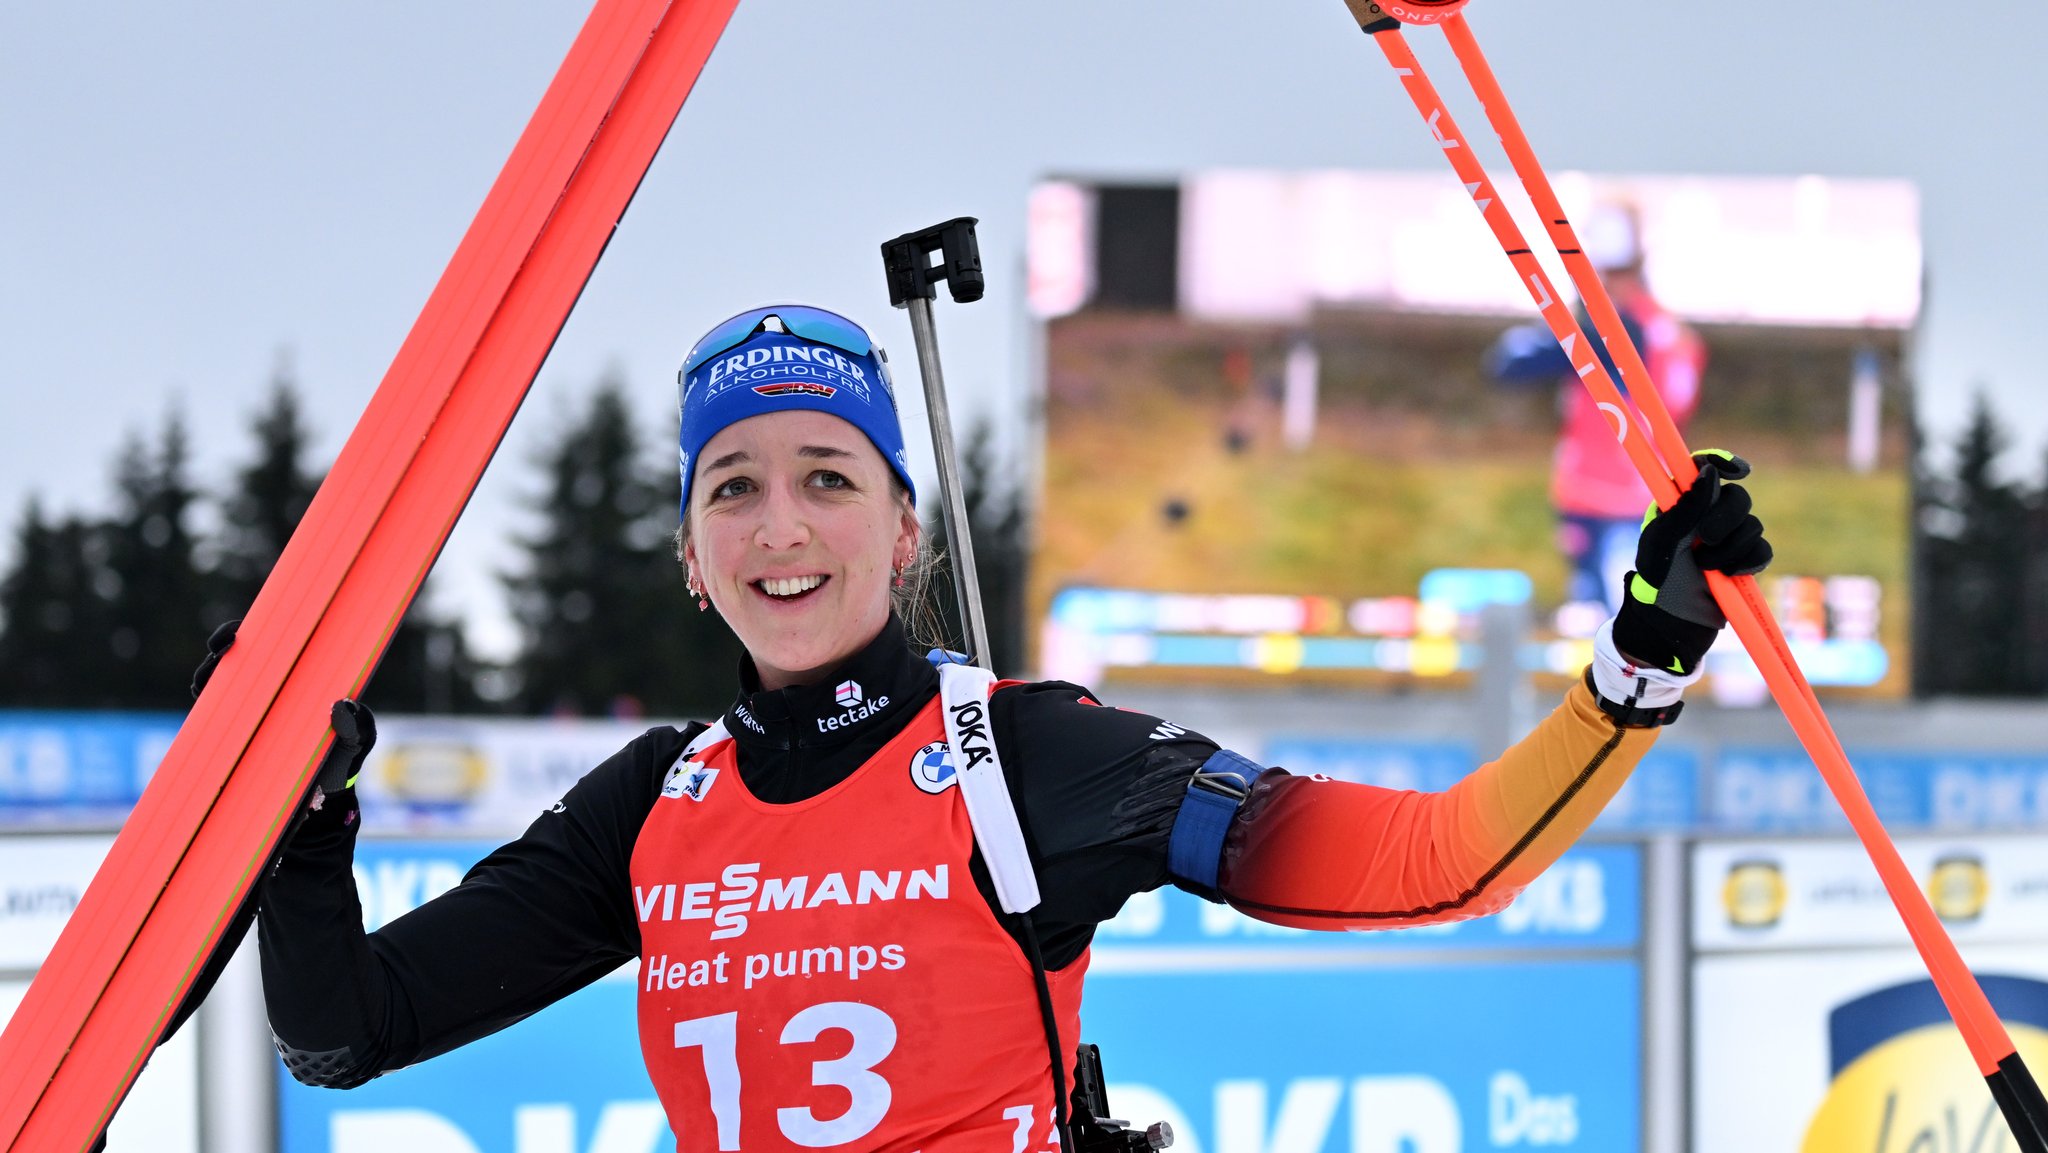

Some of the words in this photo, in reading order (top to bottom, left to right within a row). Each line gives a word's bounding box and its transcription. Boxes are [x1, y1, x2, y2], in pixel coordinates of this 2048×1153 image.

[704, 365, 871, 403] ALKOHOLFREI
[707, 346, 871, 392] ERDINGER
[817, 695, 890, 733] tectake
[950, 701, 991, 771] JOKA
[922, 744, 951, 755] BM
[635, 863, 949, 940] VIESSMANN
[646, 956, 729, 992] Heat
[744, 944, 906, 990] pumps
[674, 1001, 898, 1152] 13
